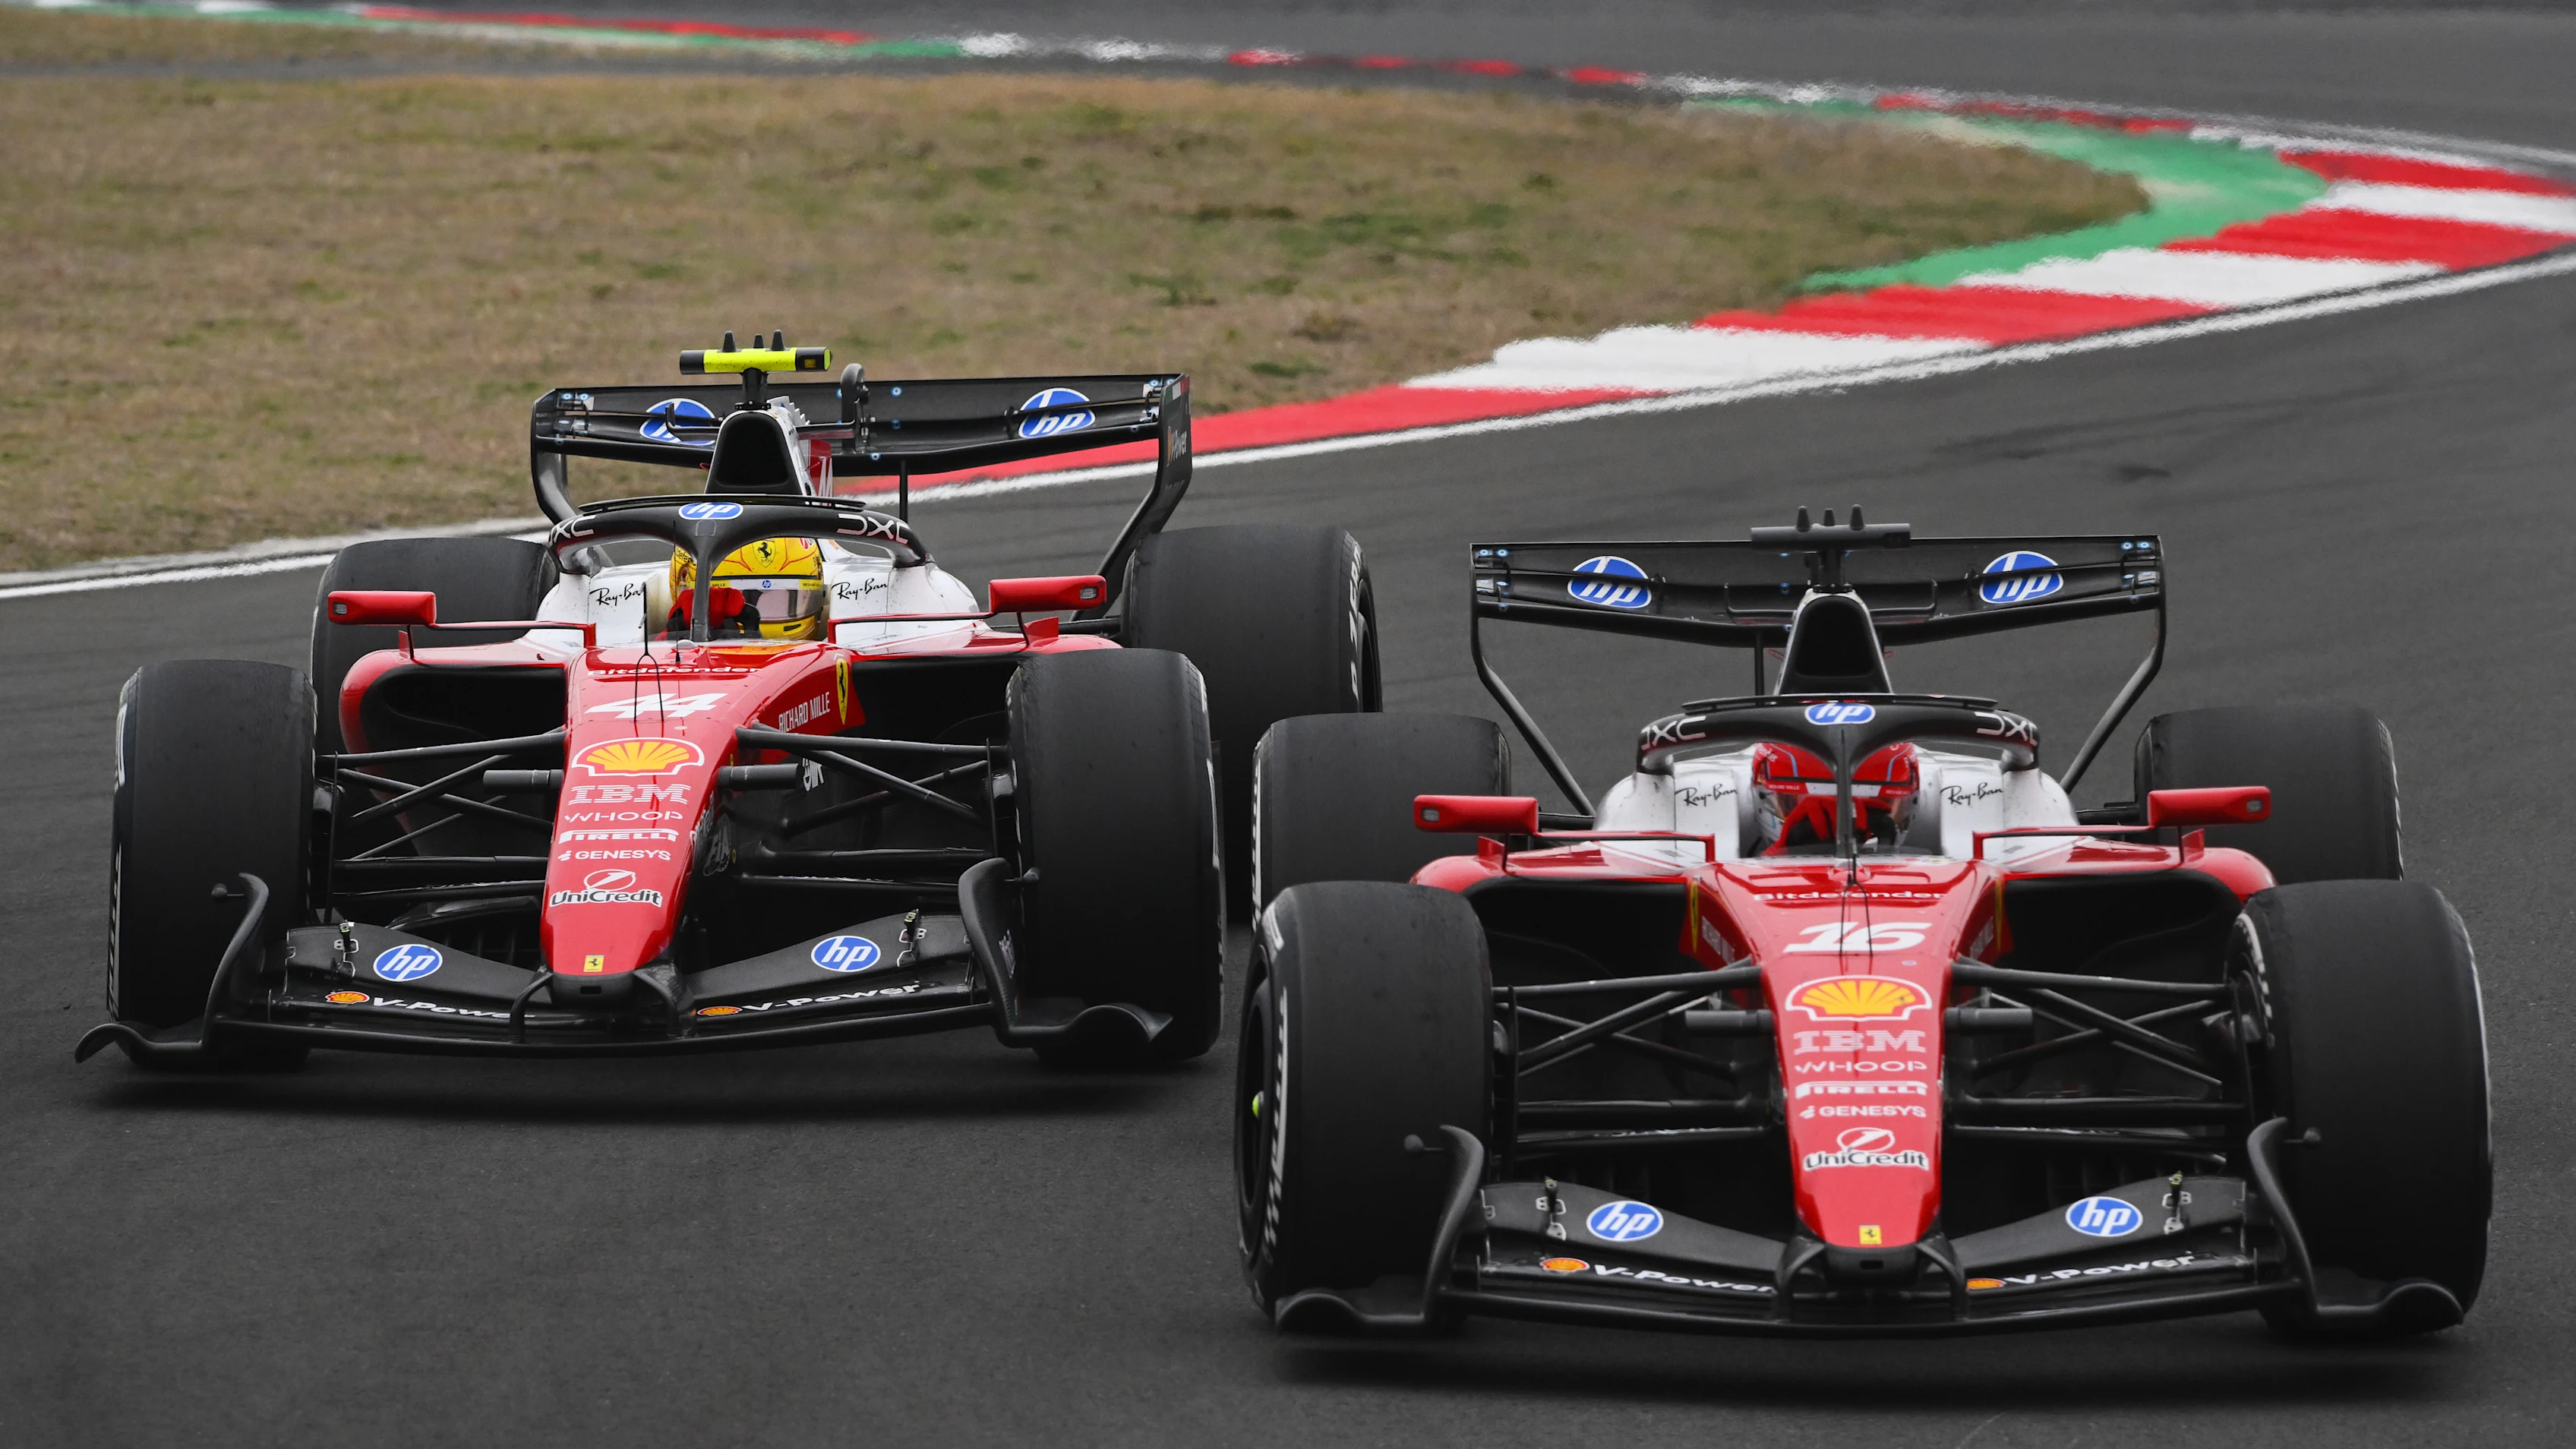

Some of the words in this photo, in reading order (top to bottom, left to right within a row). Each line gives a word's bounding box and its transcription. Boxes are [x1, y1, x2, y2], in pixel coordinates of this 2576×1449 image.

[1028, 390, 1087, 437] hp
[687, 503, 737, 519] hp
[837, 513, 911, 544] DXC
[1580, 557, 1642, 607] hp
[1993, 552, 2050, 601] hp
[831, 578, 889, 600] Ray-Ban
[587, 667, 762, 676] Bitdefender
[584, 693, 728, 718] 44
[778, 702, 808, 733] RICHARD
[810, 691, 830, 720] MILLE
[1817, 703, 1869, 722] hp
[568, 784, 691, 805] IBM
[1675, 783, 1738, 807] Ray-Ban
[1940, 781, 2003, 805] Ray-Ban
[564, 811, 683, 822] WHOOP
[559, 828, 679, 844] PIRELLI
[575, 849, 671, 861] GENESYS
[551, 889, 662, 907] UniCredit
[1753, 891, 1946, 901] Bitdefender
[1782, 921, 1932, 953] 16
[381, 945, 435, 981] hp
[822, 936, 872, 971] hp
[741, 981, 920, 1012] V-Power
[1793, 1030, 1927, 1055] IBM
[1795, 1061, 1927, 1075] WHOOP
[1795, 1081, 1927, 1099] PIRELLI
[1819, 1105, 1927, 1118] GENESYS
[1804, 1151, 1929, 1170] UniCredit
[1597, 1201, 1653, 1241] hp
[2079, 1198, 2132, 1236] hp
[2003, 1254, 2196, 1285] V-Power
